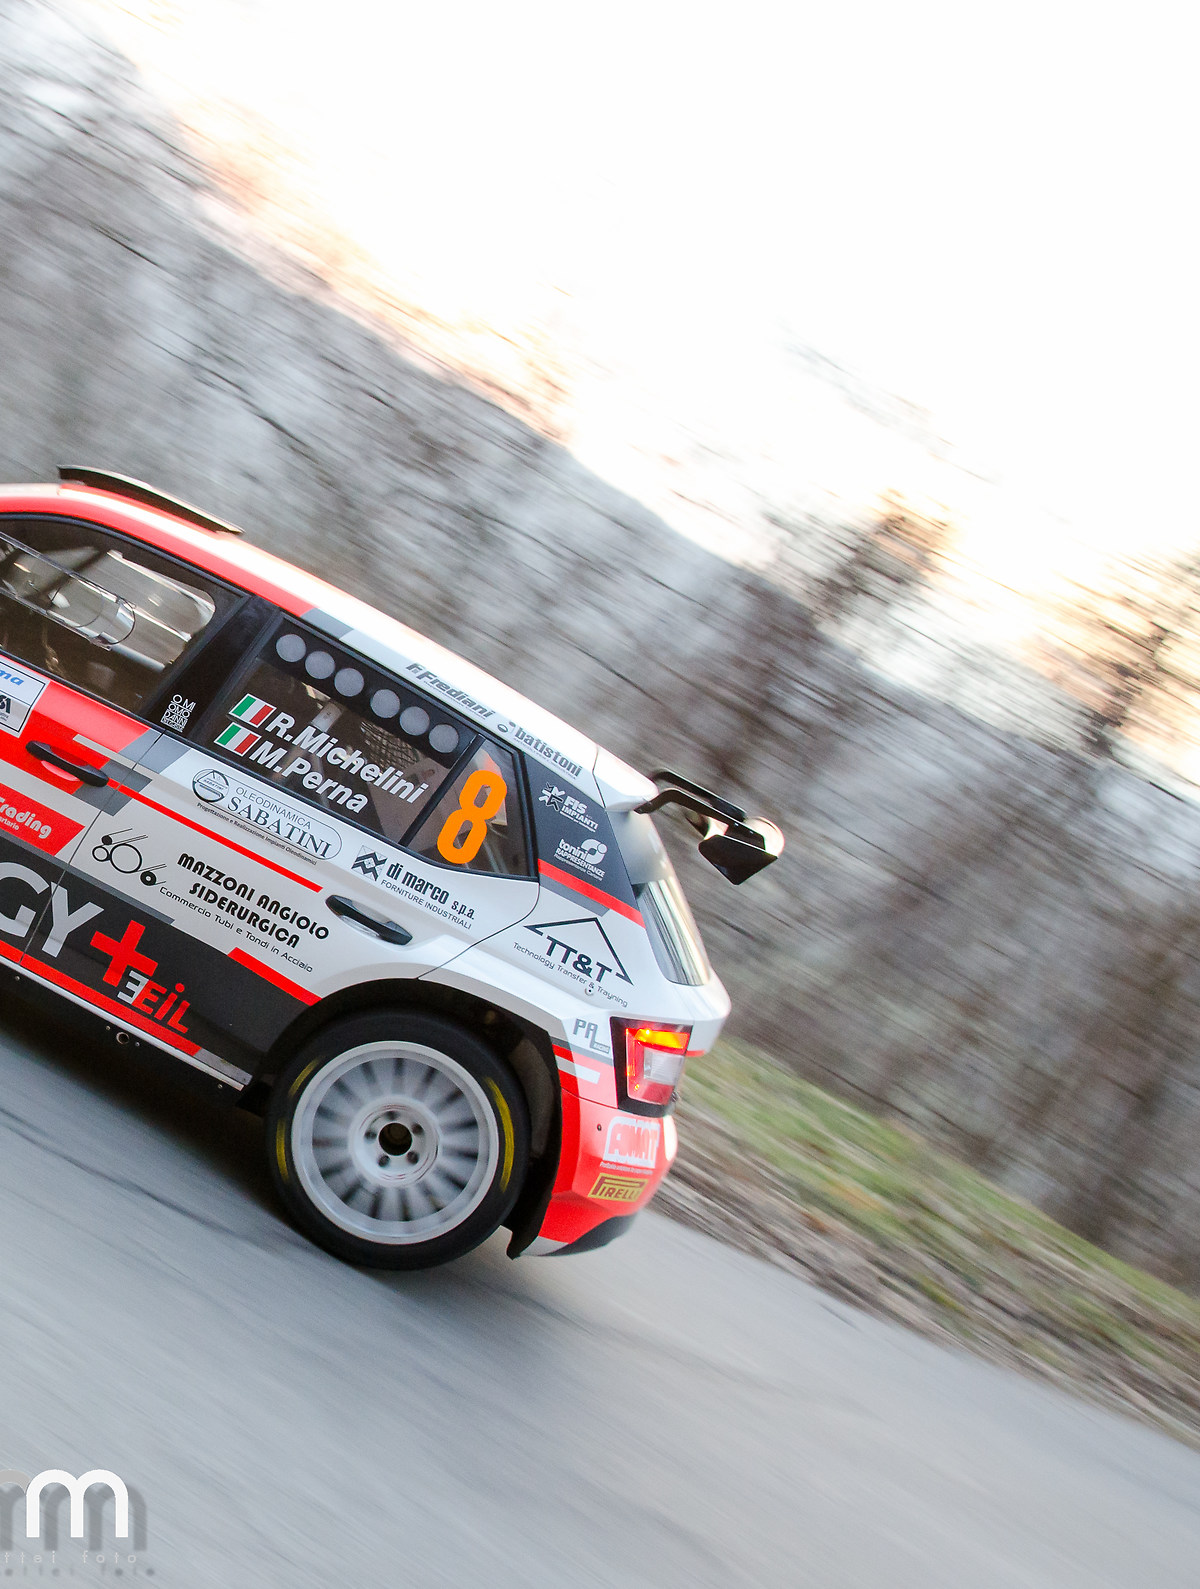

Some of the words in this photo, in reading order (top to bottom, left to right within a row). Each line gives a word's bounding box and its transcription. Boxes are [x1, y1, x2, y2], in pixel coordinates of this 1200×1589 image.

[416, 669, 496, 719] Frediani
[266, 711, 428, 804] R.Michelini
[515, 727, 583, 777] batistoni
[249, 743, 369, 814] M.Perna
[196, 802, 230, 822] Progettazione
[233, 820, 265, 839] Realizzazione
[226, 796, 332, 859] SABATINI
[235, 786, 312, 830] OLEODINAMICA
[436, 769, 508, 865] 8
[561, 805, 599, 830] IMPIANTI
[563, 795, 587, 815] FIS
[556, 848, 606, 878] RAPPRESENTANZE
[559, 838, 588, 862] tonini
[177, 852, 257, 902] MAZZONI
[257, 894, 330, 940] ANGIOLO
[380, 880, 424, 909] FORNITURE
[424, 902, 472, 930] INDUSTRIALI
[386, 861, 403, 881] di
[401, 869, 450, 904] marco
[451, 899, 475, 919] s.p.a.
[159, 886, 211, 918] Commercio
[214, 912, 234, 930] Tubi
[235, 926, 243, 934] e
[245, 929, 270, 950] Tondi
[270, 944, 281, 955] in
[281, 950, 313, 973] Acciaio
[189, 882, 301, 949] SIDERURGICA
[513, 942, 555, 970] Technology
[556, 963, 587, 985] Transfer
[597, 986, 629, 1009] Trayning
[545, 935, 613, 983] TT&T
[592, 1176, 649, 1199] PIRELLI
